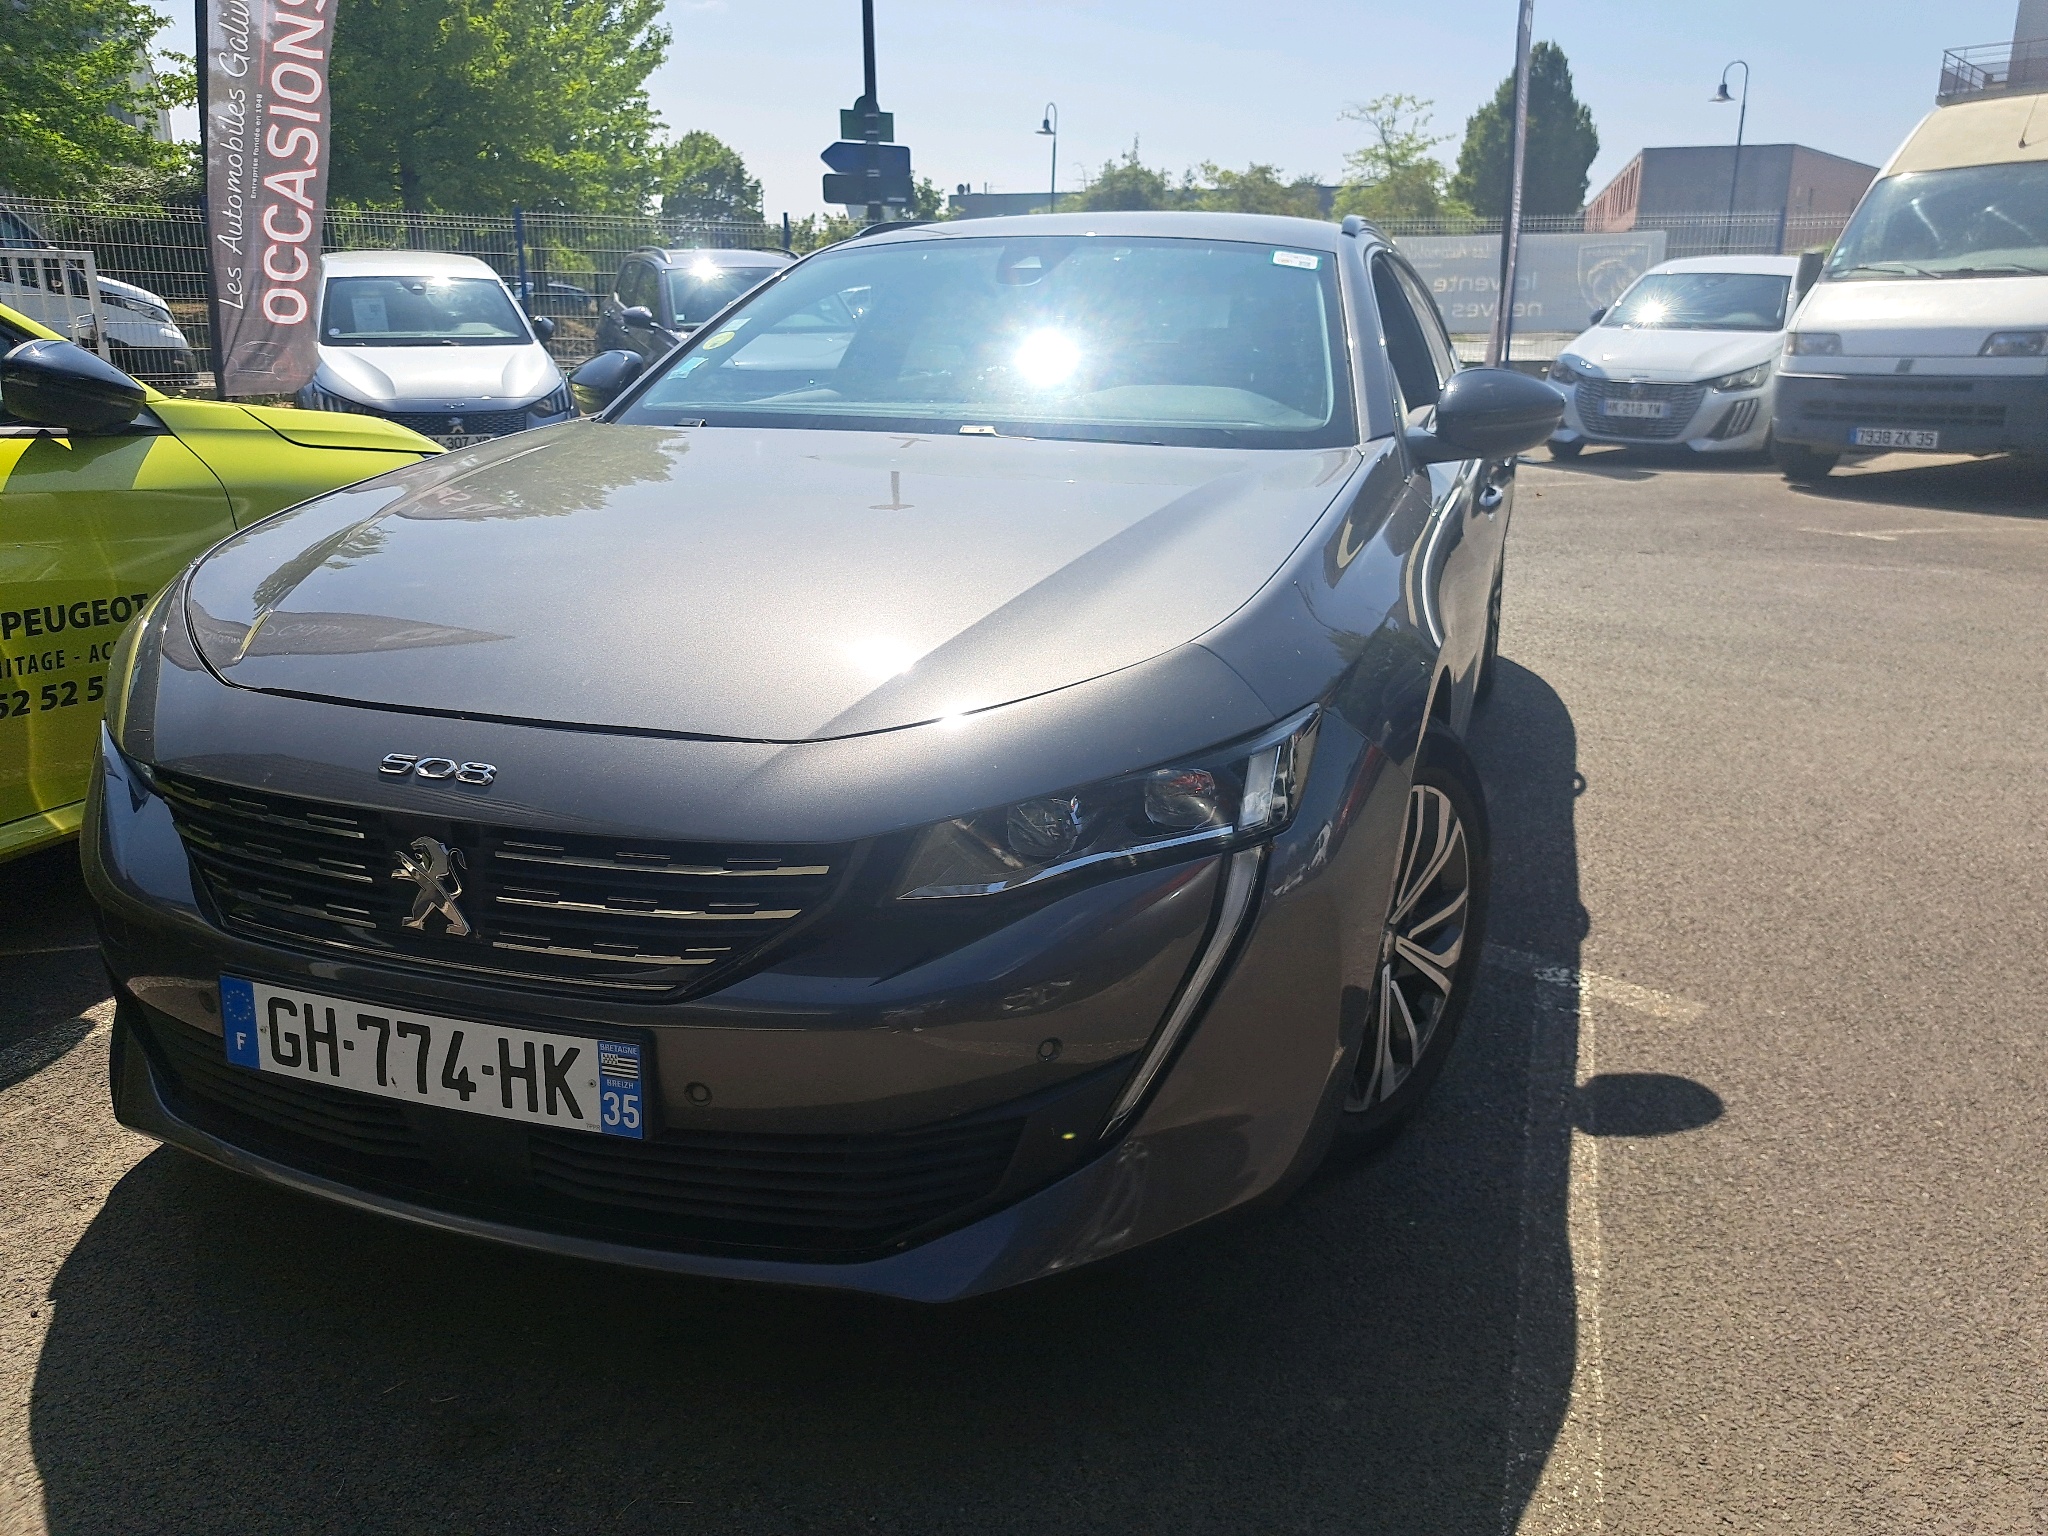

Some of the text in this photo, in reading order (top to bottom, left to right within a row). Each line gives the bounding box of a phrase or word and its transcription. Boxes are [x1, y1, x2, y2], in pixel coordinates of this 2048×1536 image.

[217, 0, 250, 310] Les Automobiles Galiv
[250, 93, 263, 199] Entreprise fondée en 1948
[1894, 431, 1911, 446] ZK
[1916, 432, 1936, 447] 35
[0, 593, 149, 641] PEUGEOT
[88, 640, 117, 664] AC
[40, 680, 79, 711] 52
[87, 675, 107, 702] 5
[378, 752, 498, 786] 508
[236, 1031, 247, 1050] F
[268, 996, 584, 1120] GH-774-HK
[600, 1043, 638, 1055] BRETAGNE
[606, 1079, 634, 1090] BREIZH
[603, 1091, 640, 1129] 35
